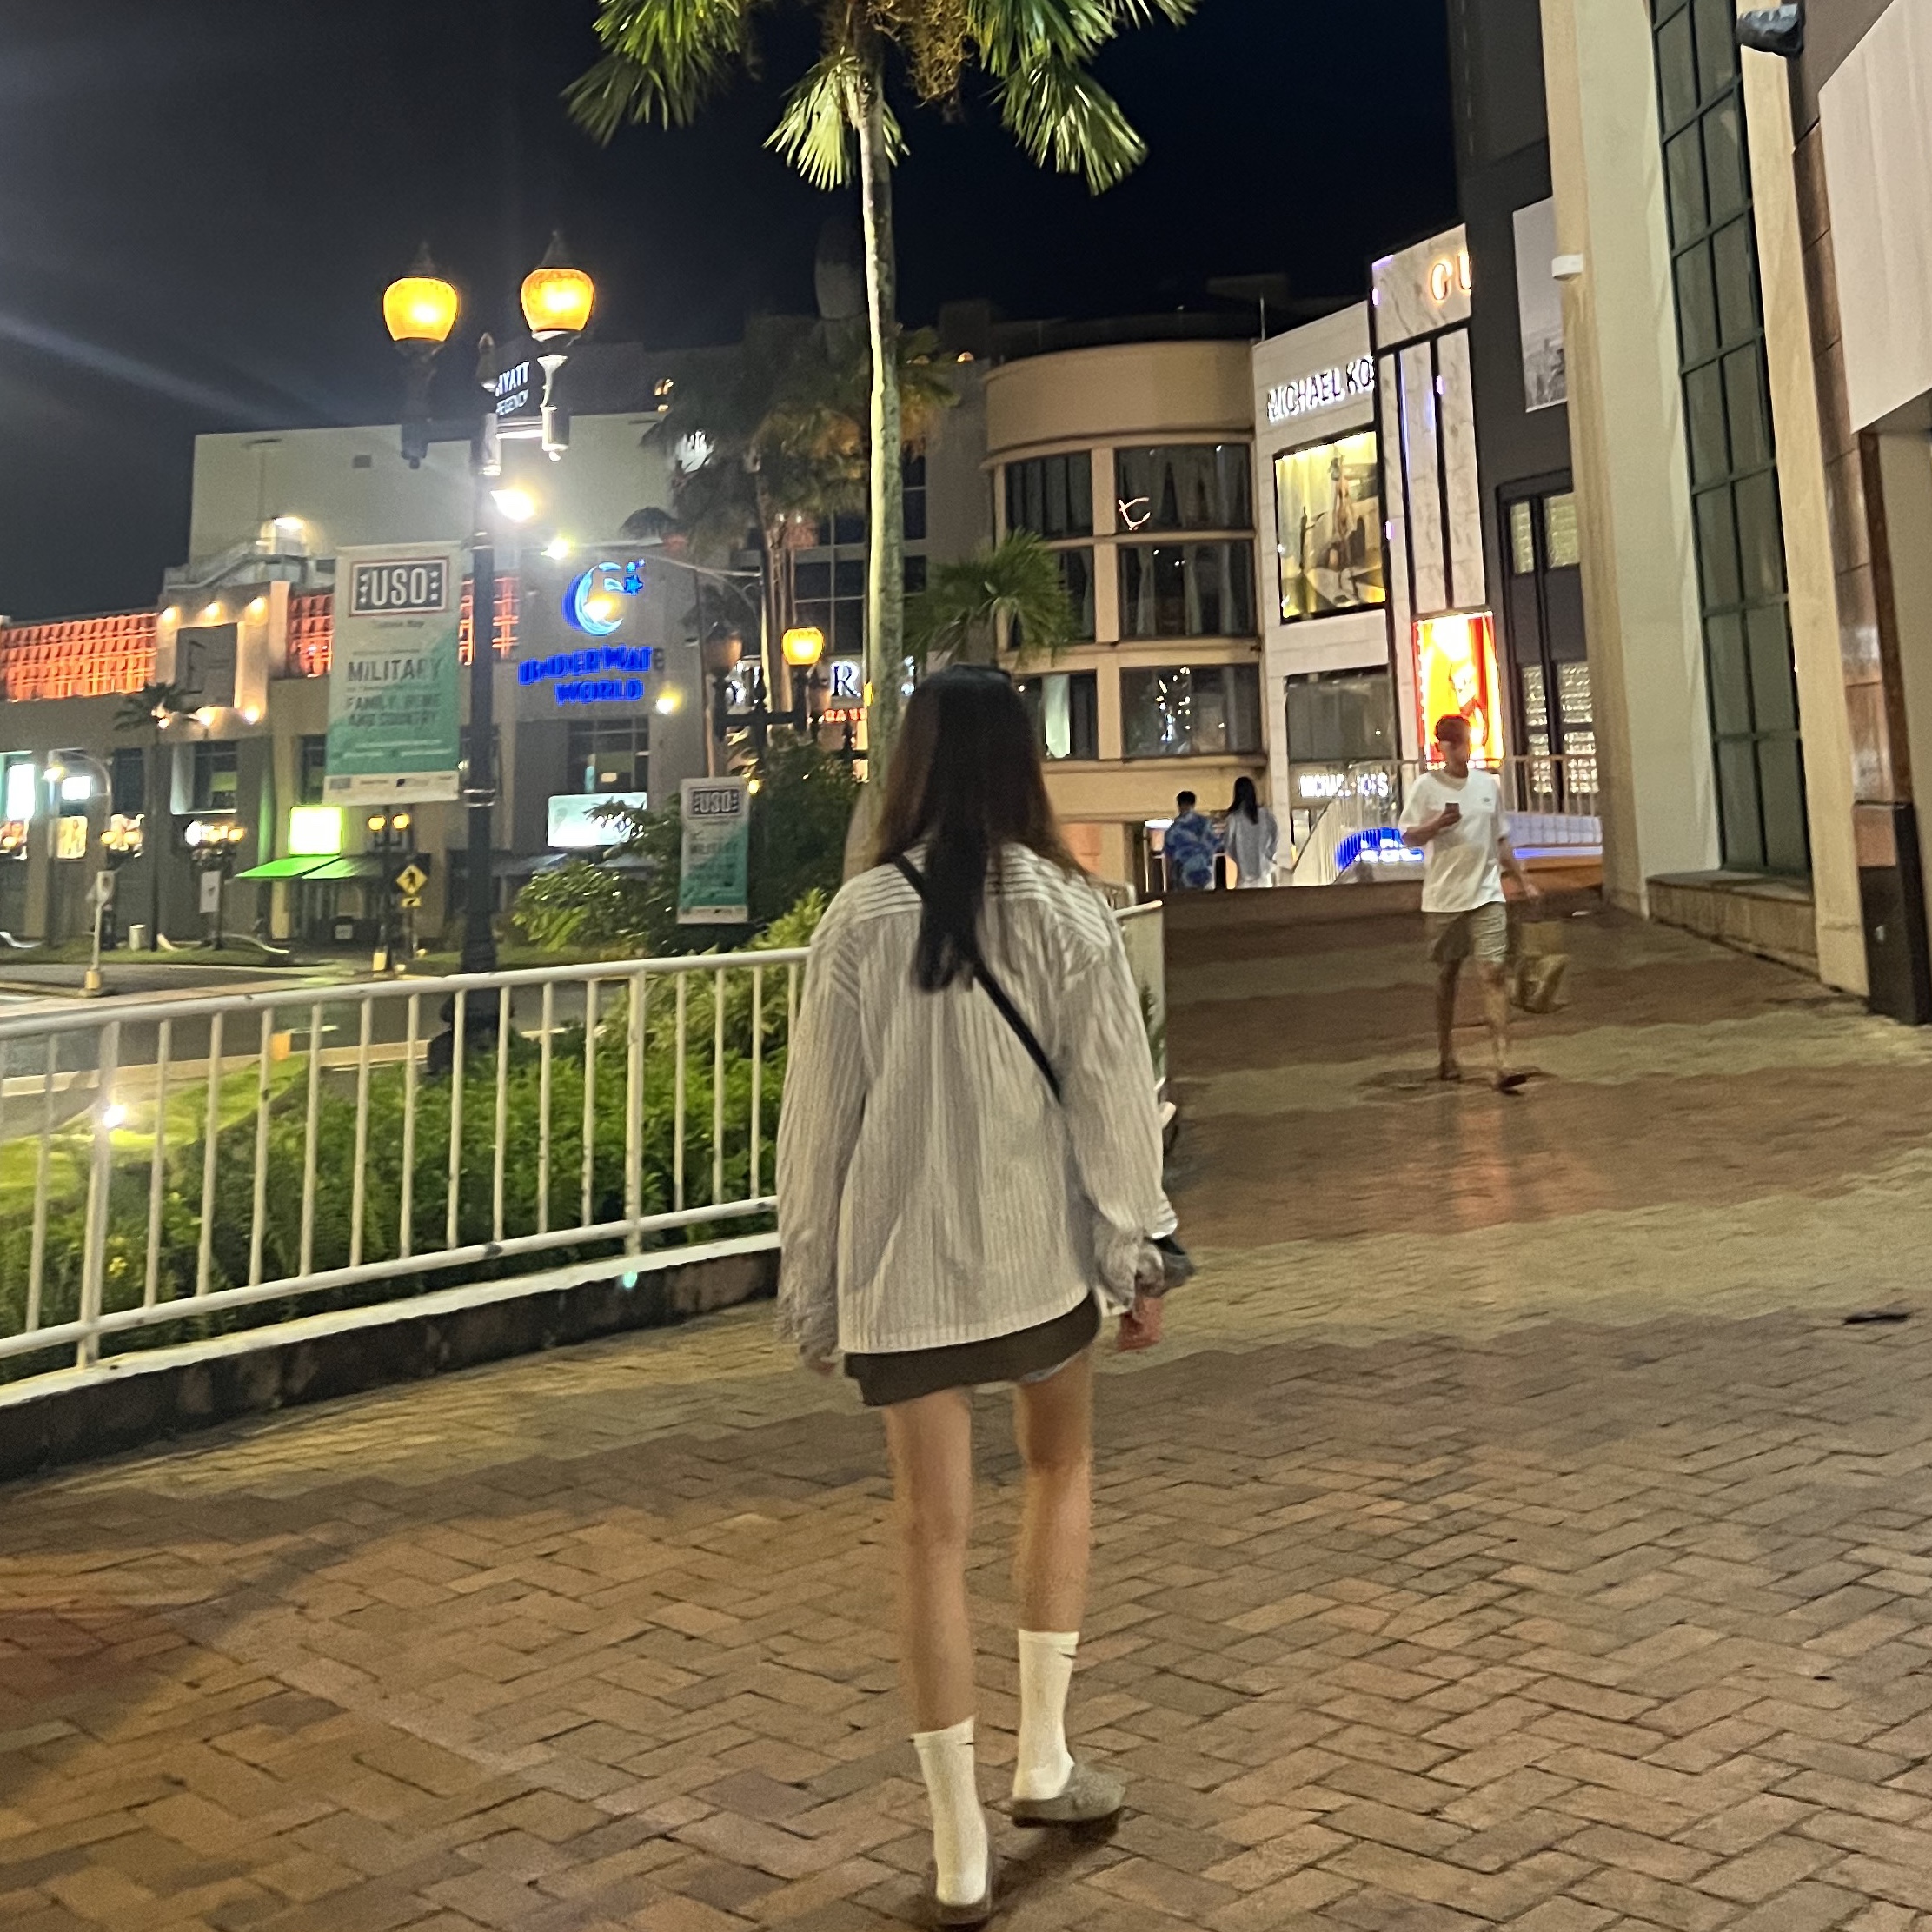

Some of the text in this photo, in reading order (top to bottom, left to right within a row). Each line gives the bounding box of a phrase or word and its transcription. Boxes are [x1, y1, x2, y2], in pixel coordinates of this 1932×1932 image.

[1267, 368, 1345, 423] MICHAEL
[371, 568, 428, 606] USO
[348, 657, 445, 682] MILITARY
[554, 678, 644, 706] WORLD
[700, 792, 732, 813] USO
